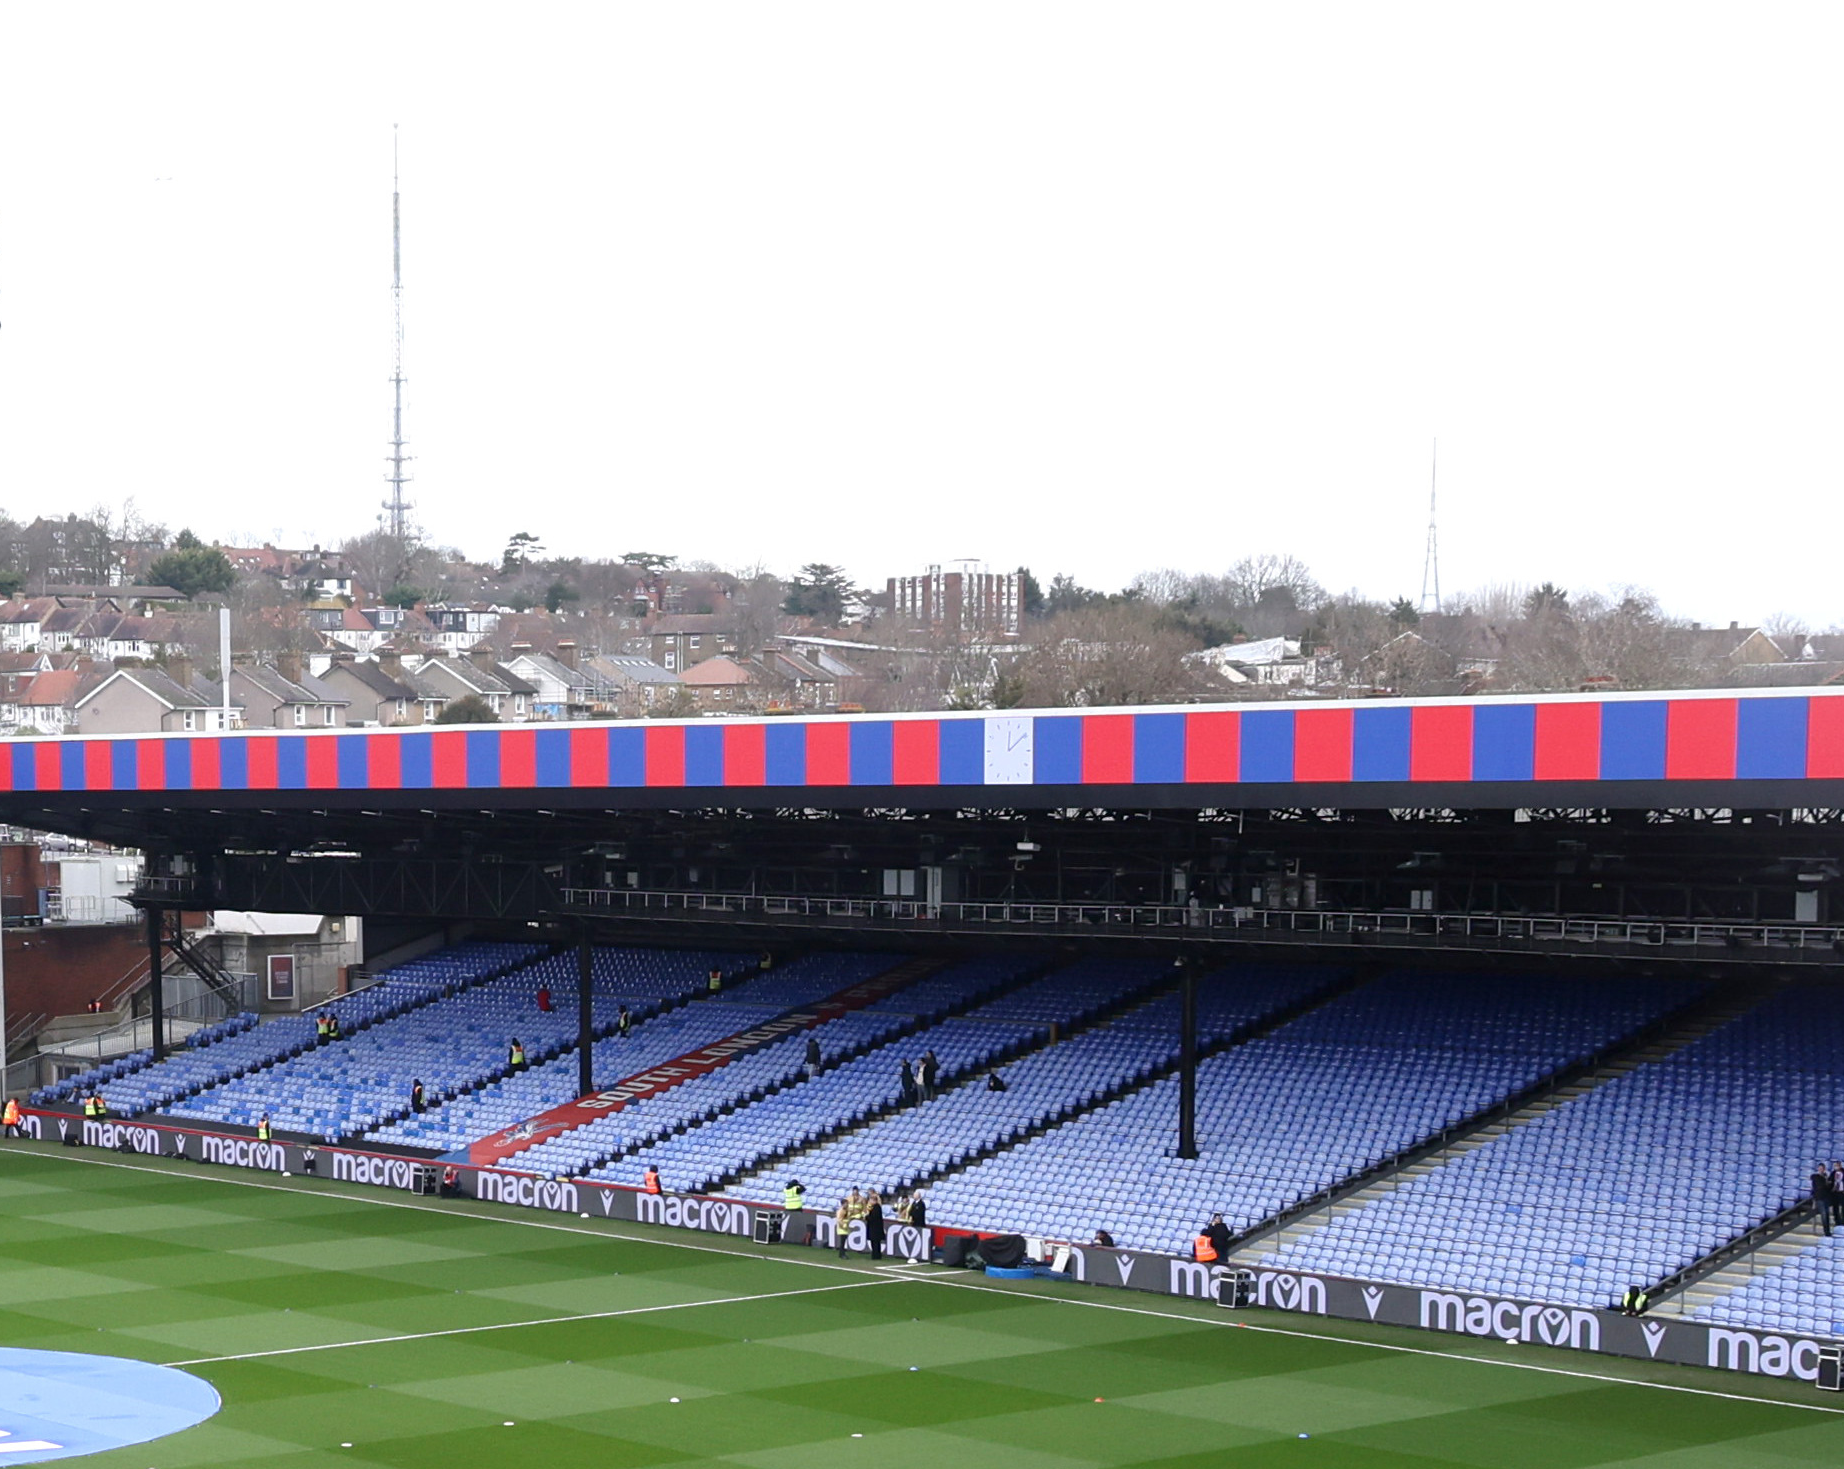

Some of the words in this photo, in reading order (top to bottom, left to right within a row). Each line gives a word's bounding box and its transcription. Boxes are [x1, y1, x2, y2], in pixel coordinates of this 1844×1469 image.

[576, 1066, 691, 1110] SOUTH
[683, 1013, 818, 1065] LONDON
[84, 1120, 160, 1155] macron
[202, 1136, 285, 1171] macron
[477, 1171, 578, 1213] macron
[637, 1192, 749, 1236] macron
[816, 1215, 931, 1260] maro
[1420, 1291, 1600, 1351] macron
